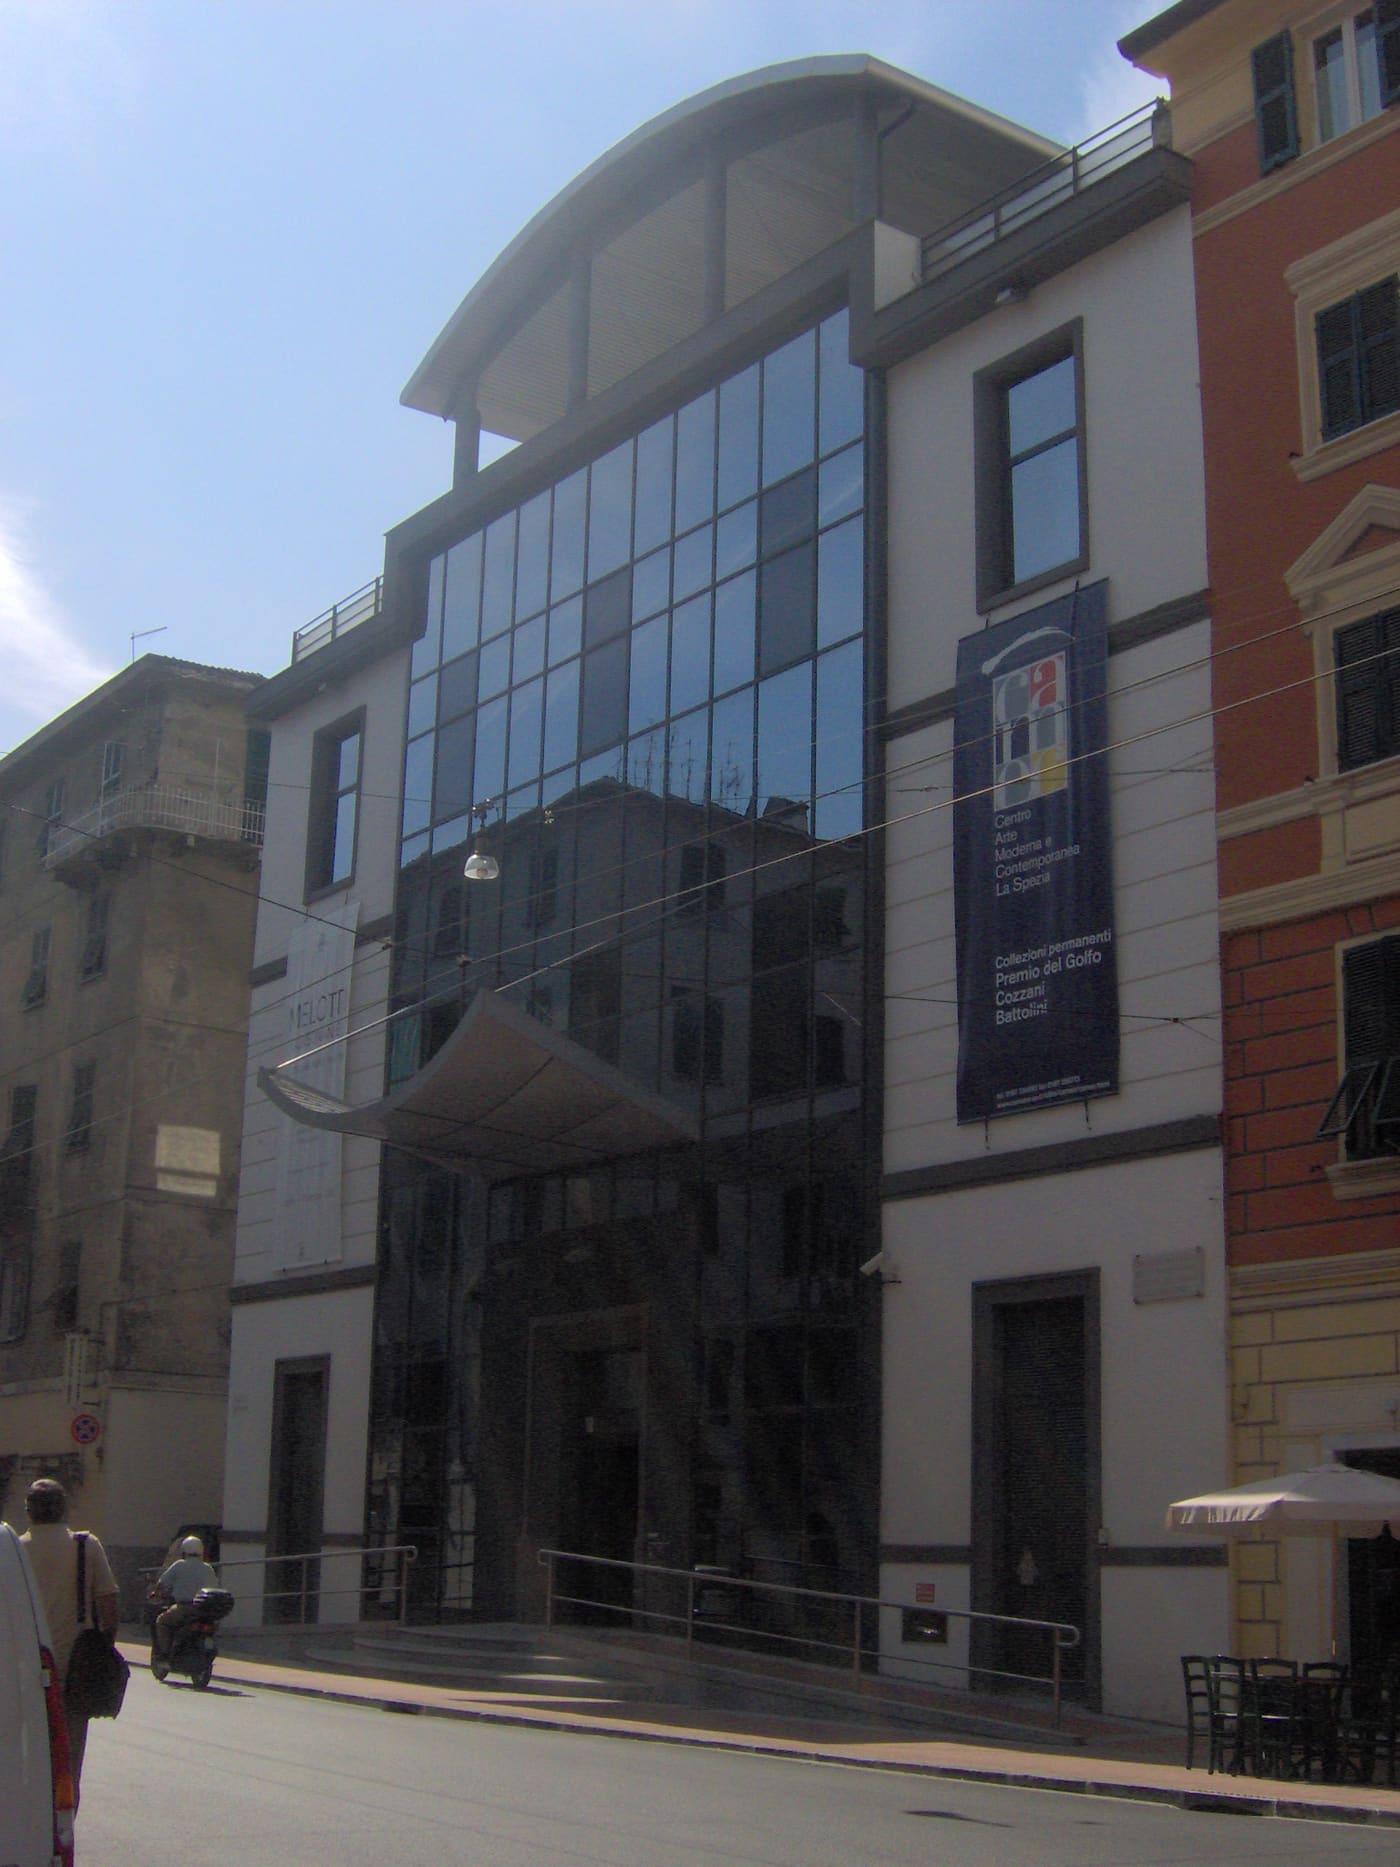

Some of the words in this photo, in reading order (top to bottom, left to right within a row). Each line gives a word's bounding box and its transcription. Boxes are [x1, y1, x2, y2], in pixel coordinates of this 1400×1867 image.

[995, 809, 1032, 829] Centro
[995, 831, 1018, 845] Arte
[995, 839, 1042, 861] Moderna
[1045, 836, 1052, 848] e
[996, 844, 1080, 878] Contemporanea
[996, 883, 1010, 896] La
[1013, 872, 1050, 893] Spezia
[995, 944, 1047, 968] Collezioni
[1048, 928, 1112, 957] permanenti
[996, 965, 1040, 987] Premio
[1043, 957, 1062, 976] del
[1065, 950, 1102, 968] Golfo
[996, 981, 1046, 1006] Cozzani
[996, 1000, 1048, 1025] Battolini
